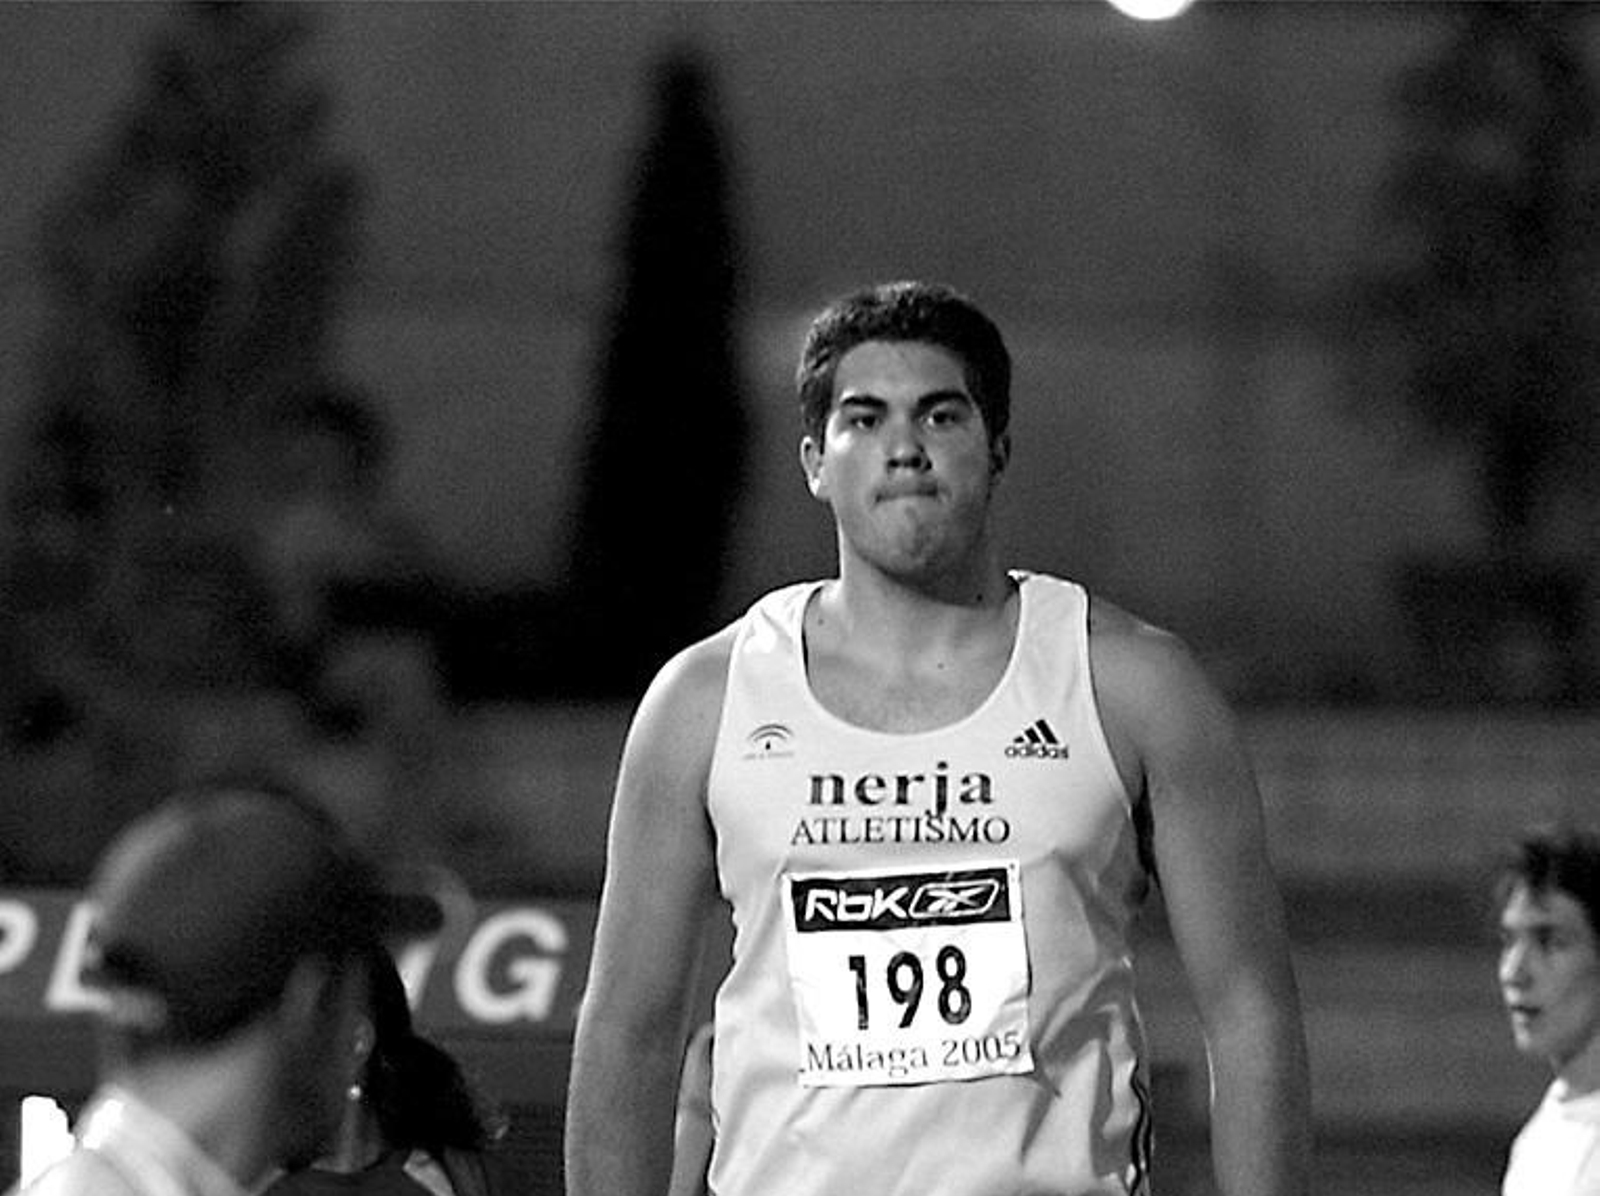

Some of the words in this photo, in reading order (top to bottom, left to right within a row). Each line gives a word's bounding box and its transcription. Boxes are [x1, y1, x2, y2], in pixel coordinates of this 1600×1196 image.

[1004, 744, 1069, 760] adidas
[810, 761, 995, 815] nerja
[791, 816, 1010, 845] ATLETISMO
[849, 945, 972, 1030] 198
[807, 1040, 928, 1078] Málaga
[941, 1031, 1021, 1067] 2005
